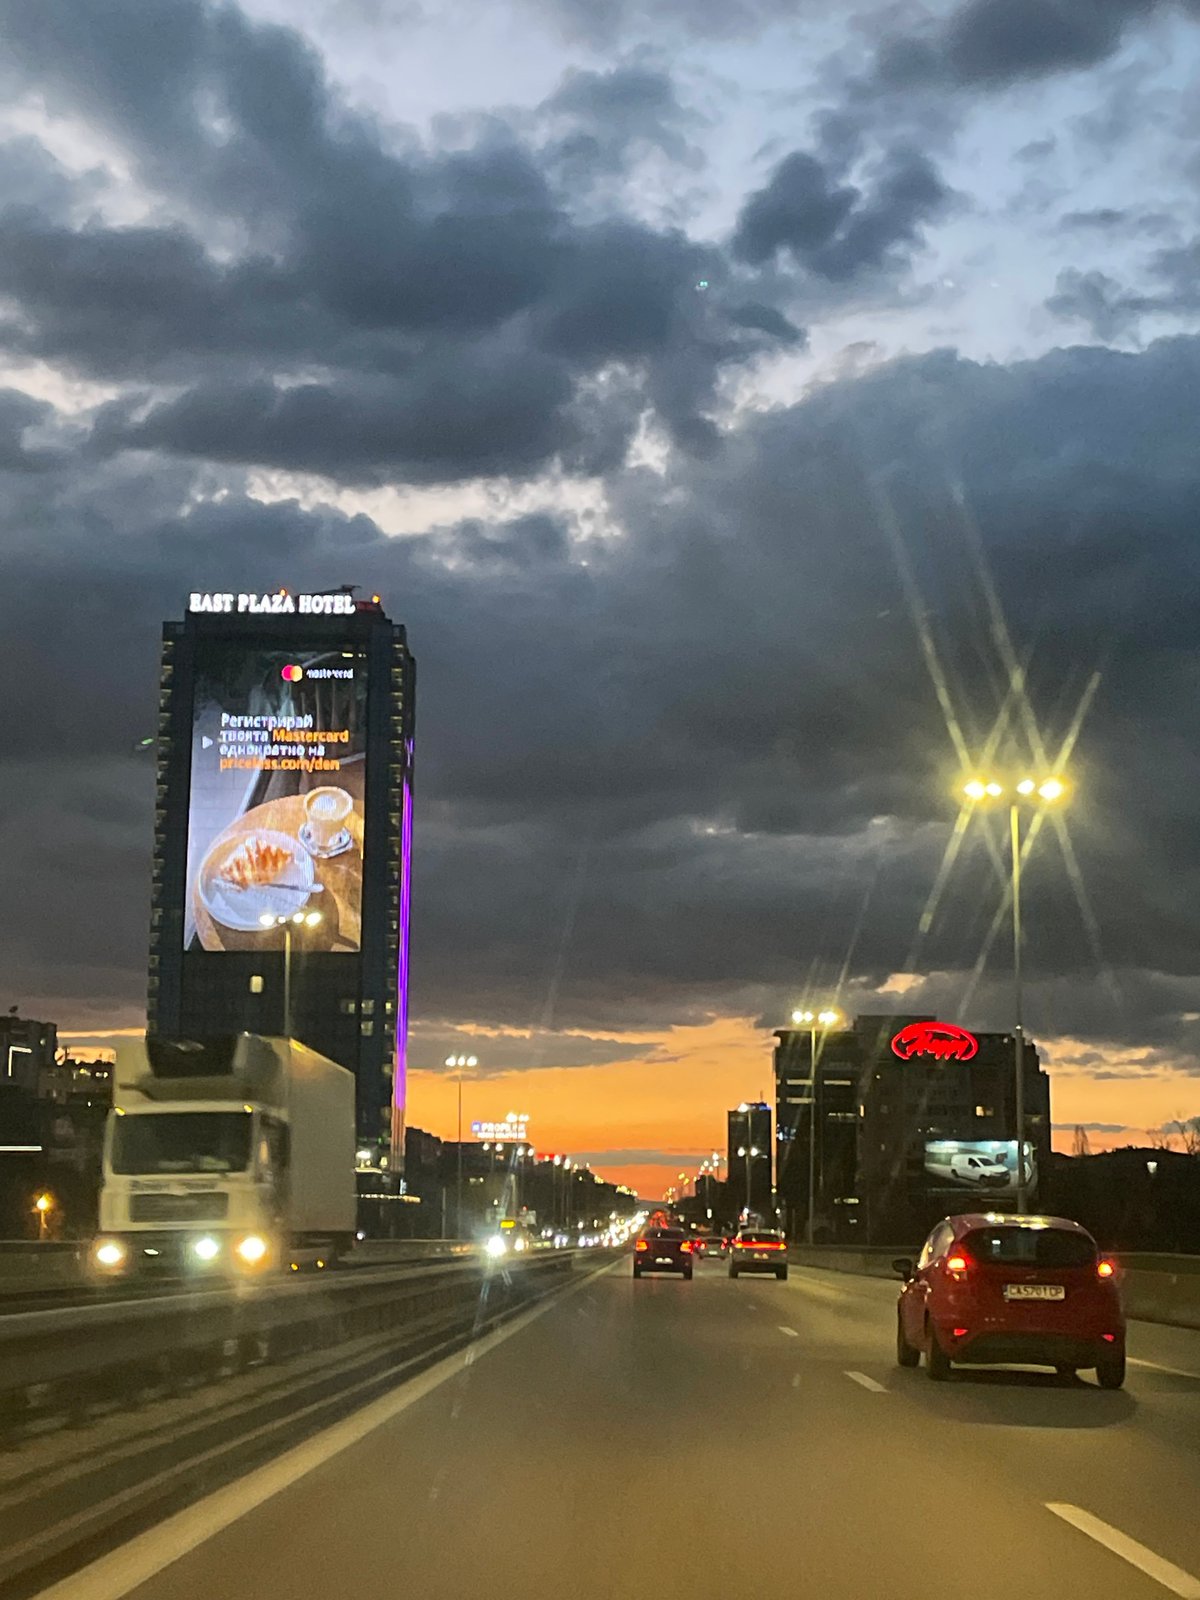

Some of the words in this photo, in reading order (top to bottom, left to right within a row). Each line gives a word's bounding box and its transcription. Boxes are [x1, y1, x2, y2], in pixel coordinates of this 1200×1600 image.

[190, 593, 234, 612] EAST
[237, 594, 295, 613] PLAZA
[299, 595, 356, 614] HOTEL
[221, 713, 313, 731] Регистрирай
[220, 730, 268, 742] твоята
[273, 728, 349, 743] Mastercard
[220, 744, 305, 758] еднократно
[308, 745, 325, 756] на
[220, 757, 340, 773] priceless.com/den
